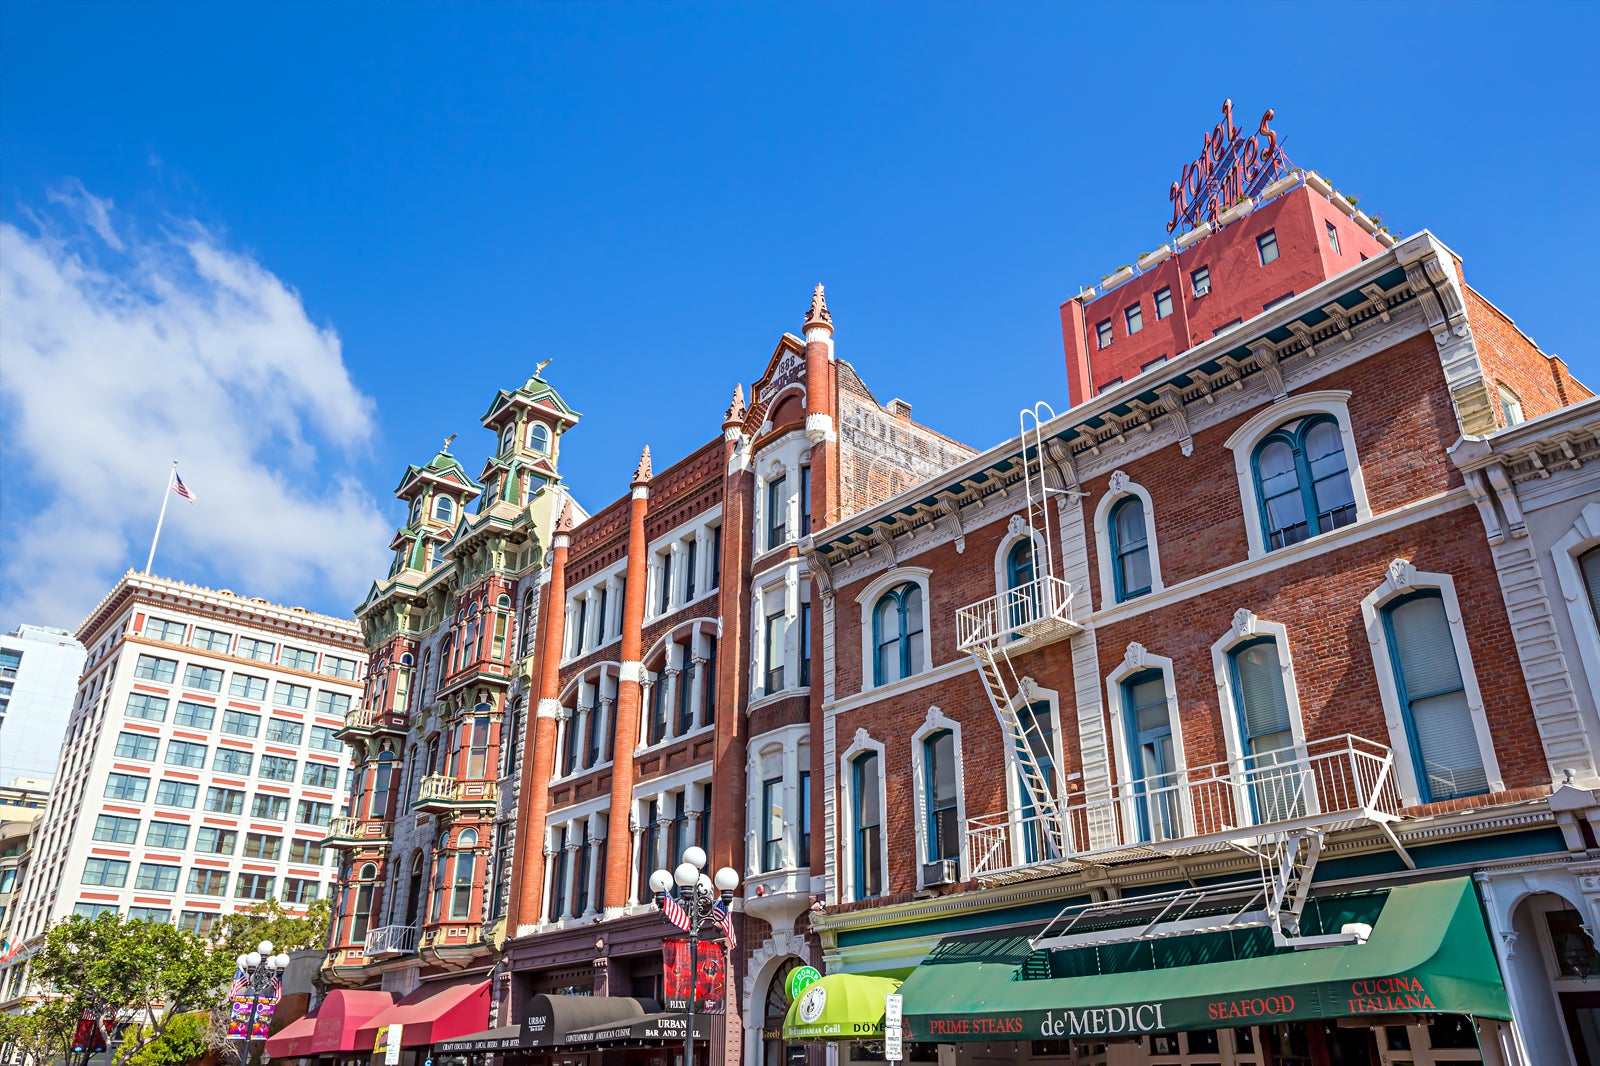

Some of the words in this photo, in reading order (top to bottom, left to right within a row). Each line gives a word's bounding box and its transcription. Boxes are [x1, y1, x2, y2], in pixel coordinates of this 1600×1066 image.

[1167, 99, 1236, 232] Hotel
[779, 355, 795, 375] 1888
[1352, 977, 1424, 996] CUCINA
[1208, 995, 1295, 1020] SEAFOOD
[1349, 993, 1436, 1014] ITALIANA
[528, 1015, 547, 1025] URBAN
[658, 1019, 687, 1029] URBAN
[854, 1022, 886, 1032] DÖNE
[930, 1019, 970, 1035] PRIME
[973, 1017, 1023, 1034] STEAKS
[566, 1033, 594, 1042] CONTEMPORARY
[596, 1030, 615, 1039] AMERICAN
[615, 1028, 631, 1037] CUISINE
[645, 1029, 661, 1037] BAR
[663, 1029, 678, 1037] AND
[680, 1030, 701, 1038] GLL
